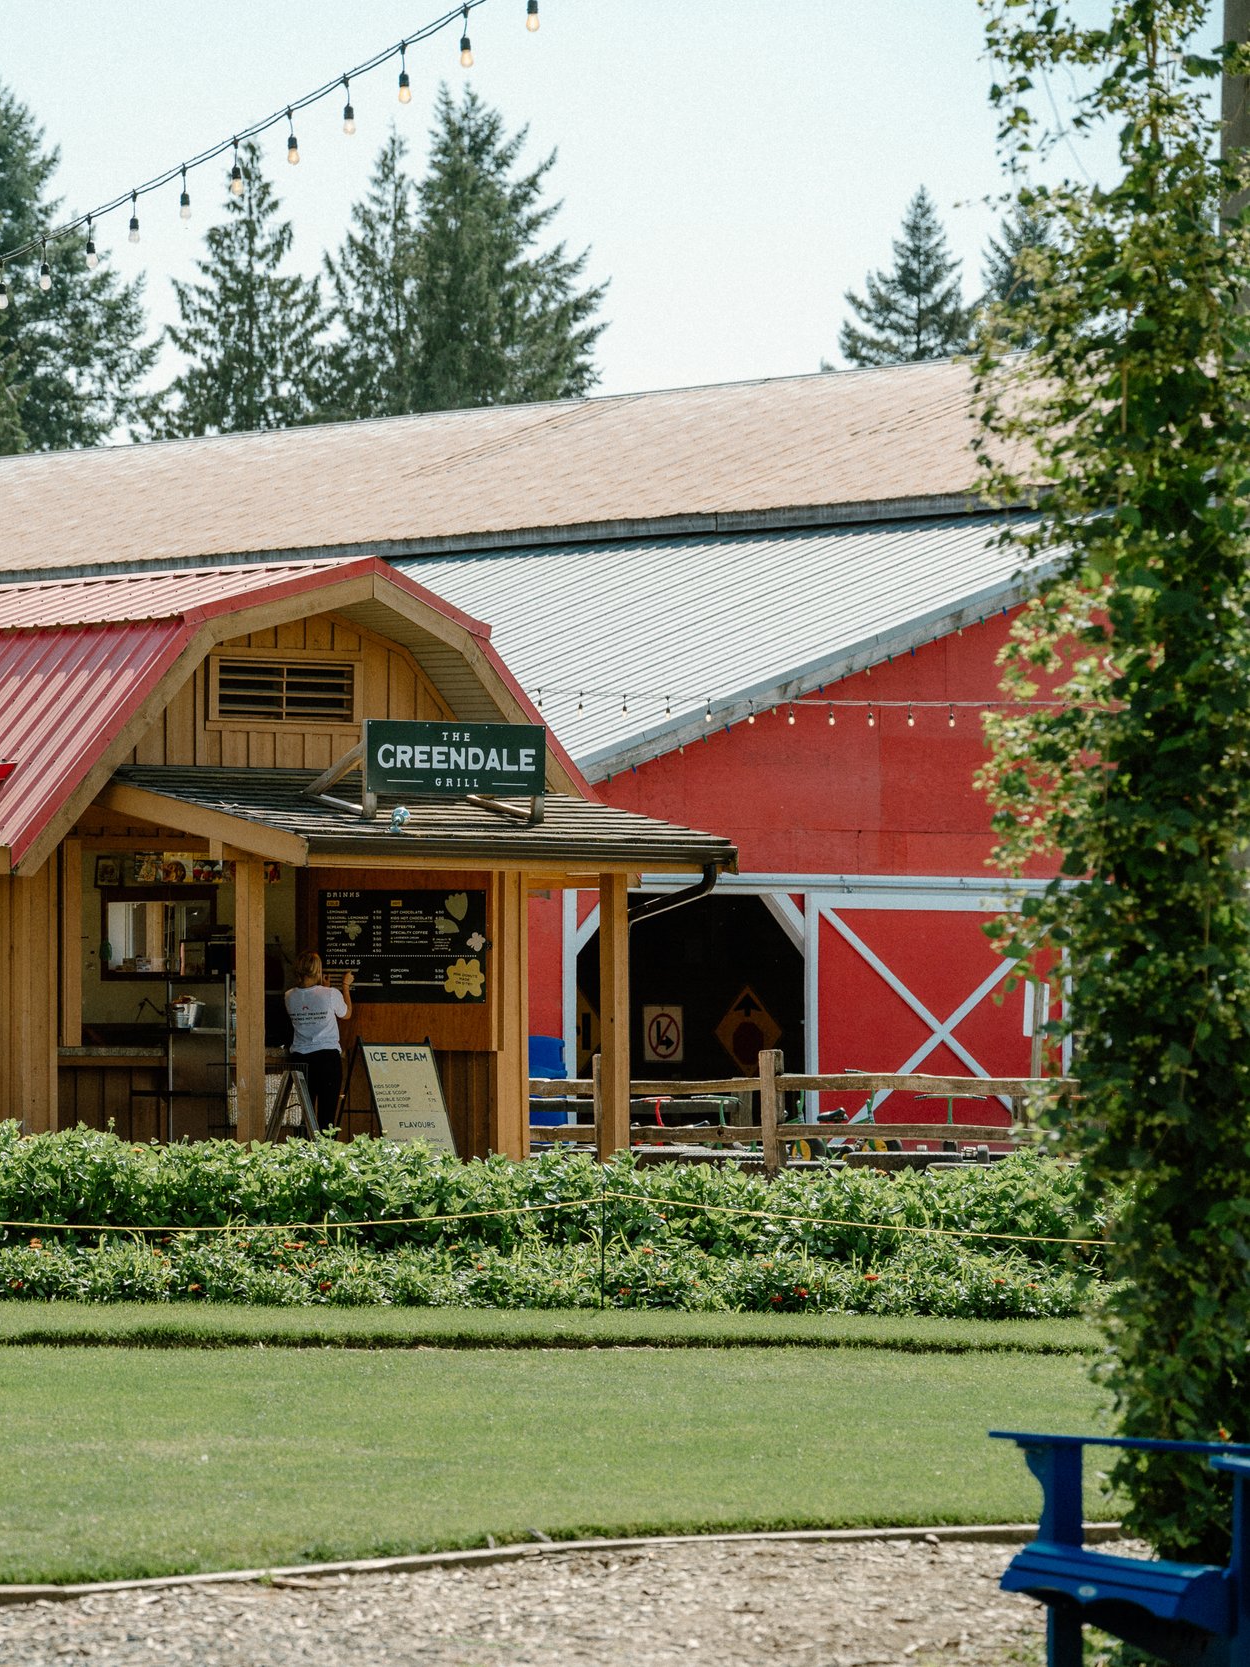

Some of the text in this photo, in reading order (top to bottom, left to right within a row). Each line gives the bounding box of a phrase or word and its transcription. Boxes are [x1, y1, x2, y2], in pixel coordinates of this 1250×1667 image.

[442, 731, 471, 741] THE
[377, 743, 536, 772] GREENDALE
[435, 777, 479, 787] GRILL
[369, 1052, 428, 1062] ICE CREAM
[398, 1121, 436, 1129] FLAVOURS
